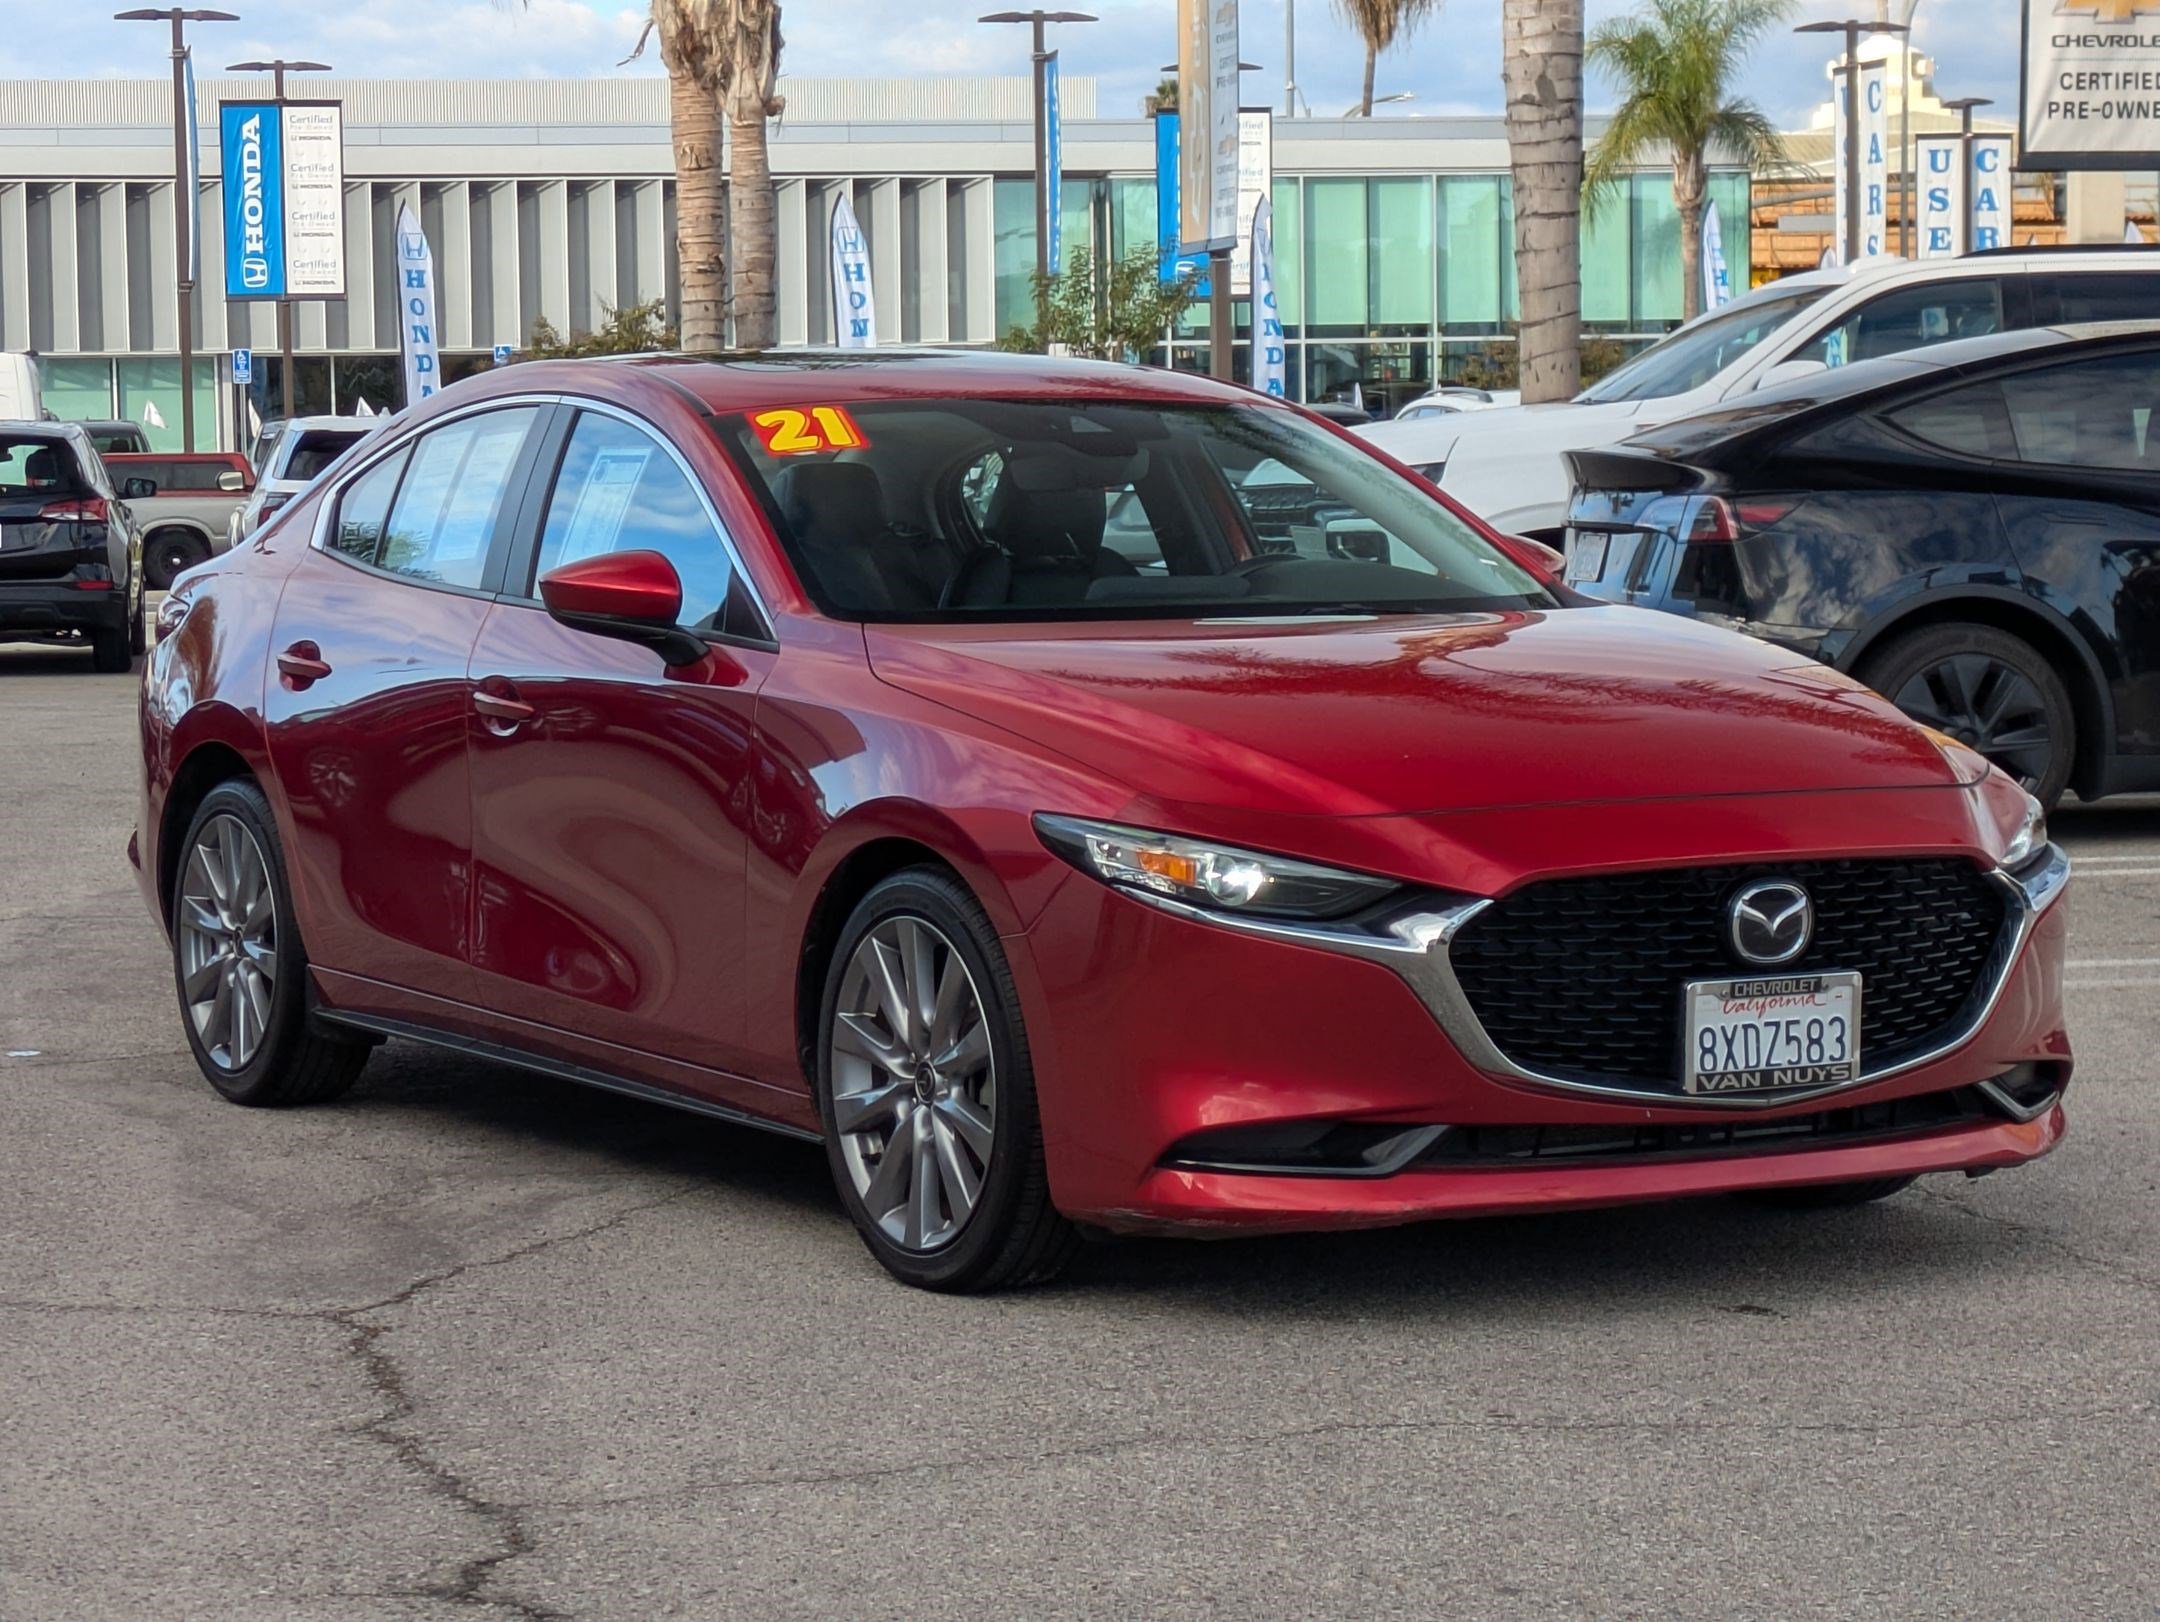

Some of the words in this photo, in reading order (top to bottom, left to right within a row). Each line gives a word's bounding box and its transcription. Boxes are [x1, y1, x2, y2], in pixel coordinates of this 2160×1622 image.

[289, 114, 333, 124] Certified
[290, 163, 334, 172] Certified
[1867, 80, 1883, 256] CARS
[241, 113, 264, 254] HONDA
[291, 211, 335, 221] Certified
[293, 260, 337, 270] Certified
[755, 408, 857, 452] 21
[1734, 978, 1817, 997] CHEVROLET
[1722, 993, 1826, 1019] California
[1699, 1016, 1846, 1072] 8XDZ583
[1700, 1072, 1761, 1090] VAN
[1773, 1064, 1850, 1086] NUYS
